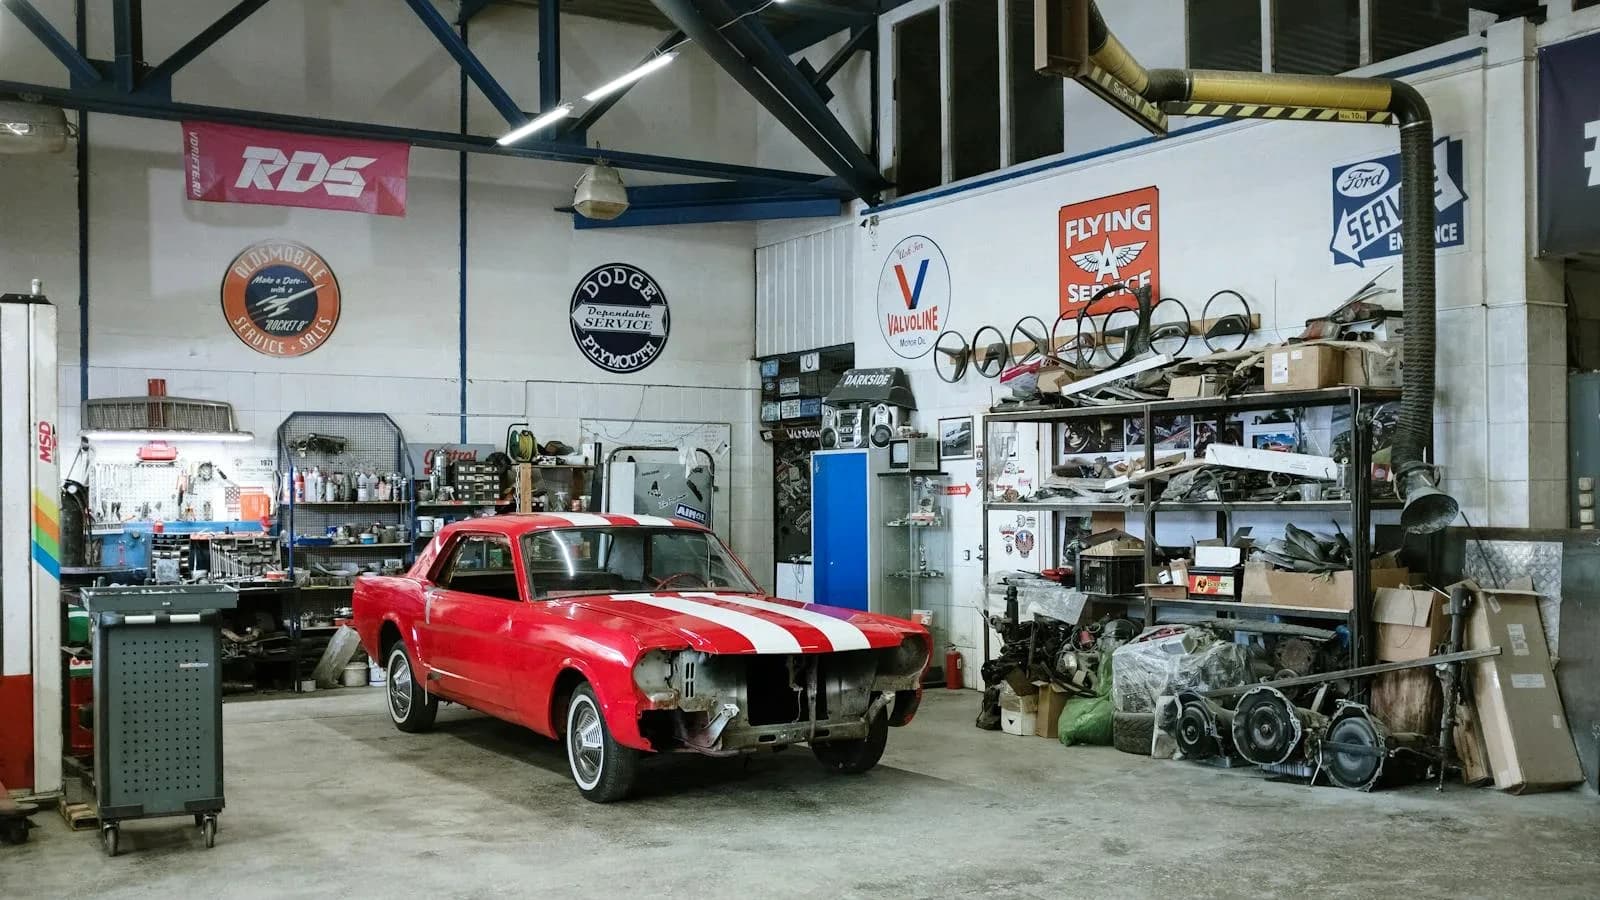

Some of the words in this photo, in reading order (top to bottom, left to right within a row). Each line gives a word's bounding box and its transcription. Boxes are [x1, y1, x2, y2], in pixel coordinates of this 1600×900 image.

[235, 145, 378, 198] RDS
[1342, 168, 1385, 192] Ford
[1347, 164, 1442, 250] SERV
[1065, 203, 1152, 250] FLYING
[1389, 223, 1457, 251] ENNCE
[235, 246, 327, 281] OLDSMOBILE
[251, 275, 274, 285] Make
[582, 268, 657, 301] DODGE
[583, 318, 653, 330] SERVICE
[587, 306, 651, 319] Dependable
[887, 305, 938, 337] VALVOLINE
[233, 316, 285, 354] SERVICE
[300, 317, 332, 350] SALES
[581, 334, 657, 368] PLYMOUTH
[844, 374, 891, 386] DARKSIDE
[39, 421, 52, 464] MSD
